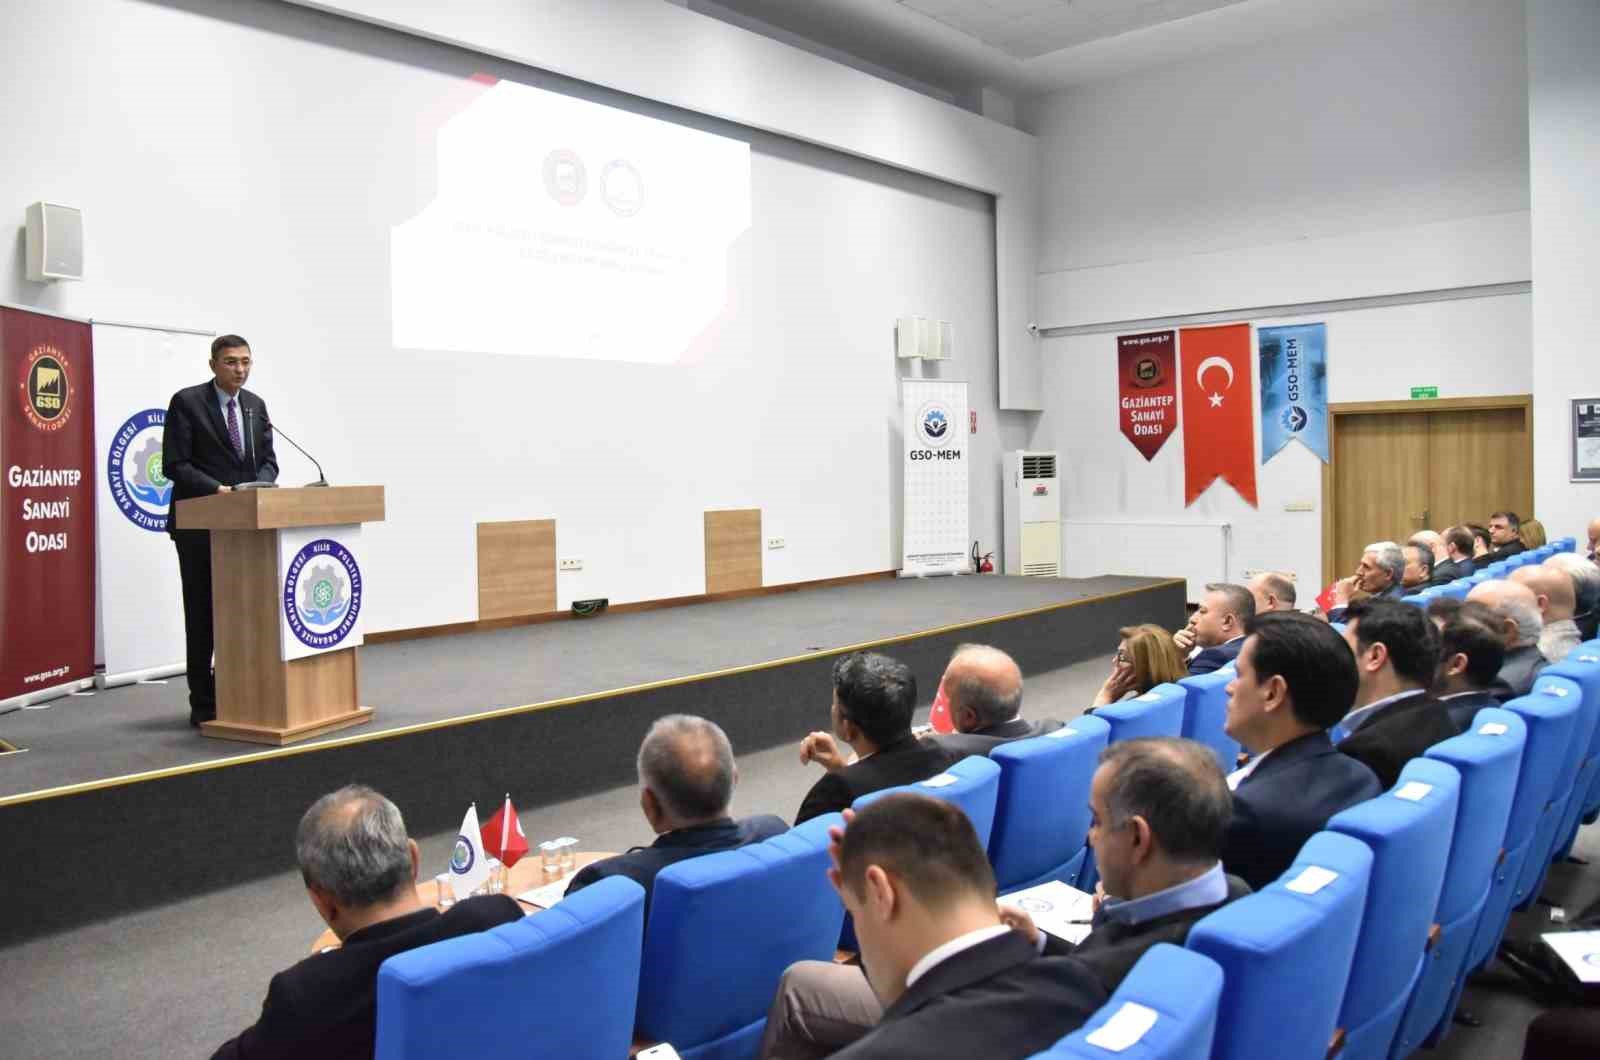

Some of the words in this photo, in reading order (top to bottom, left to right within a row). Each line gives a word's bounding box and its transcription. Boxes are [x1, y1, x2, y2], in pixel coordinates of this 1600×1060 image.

[1287, 338, 1299, 401] GSO-MEM
[36, 396, 60, 409] GSO
[1122, 395, 1174, 409] GAZİANTEP
[1134, 424, 1162, 436] ODASI
[112, 421, 137, 466] BÖLGESİ
[910, 449, 961, 461] GSO-MEM
[8, 465, 82, 488] GAZİANTEP
[110, 470, 132, 510] SANAYİ
[23, 496, 70, 520] SANAYİ
[26, 531, 67, 553] ODASI
[24, 665, 70, 684] www.gso.org.tr
